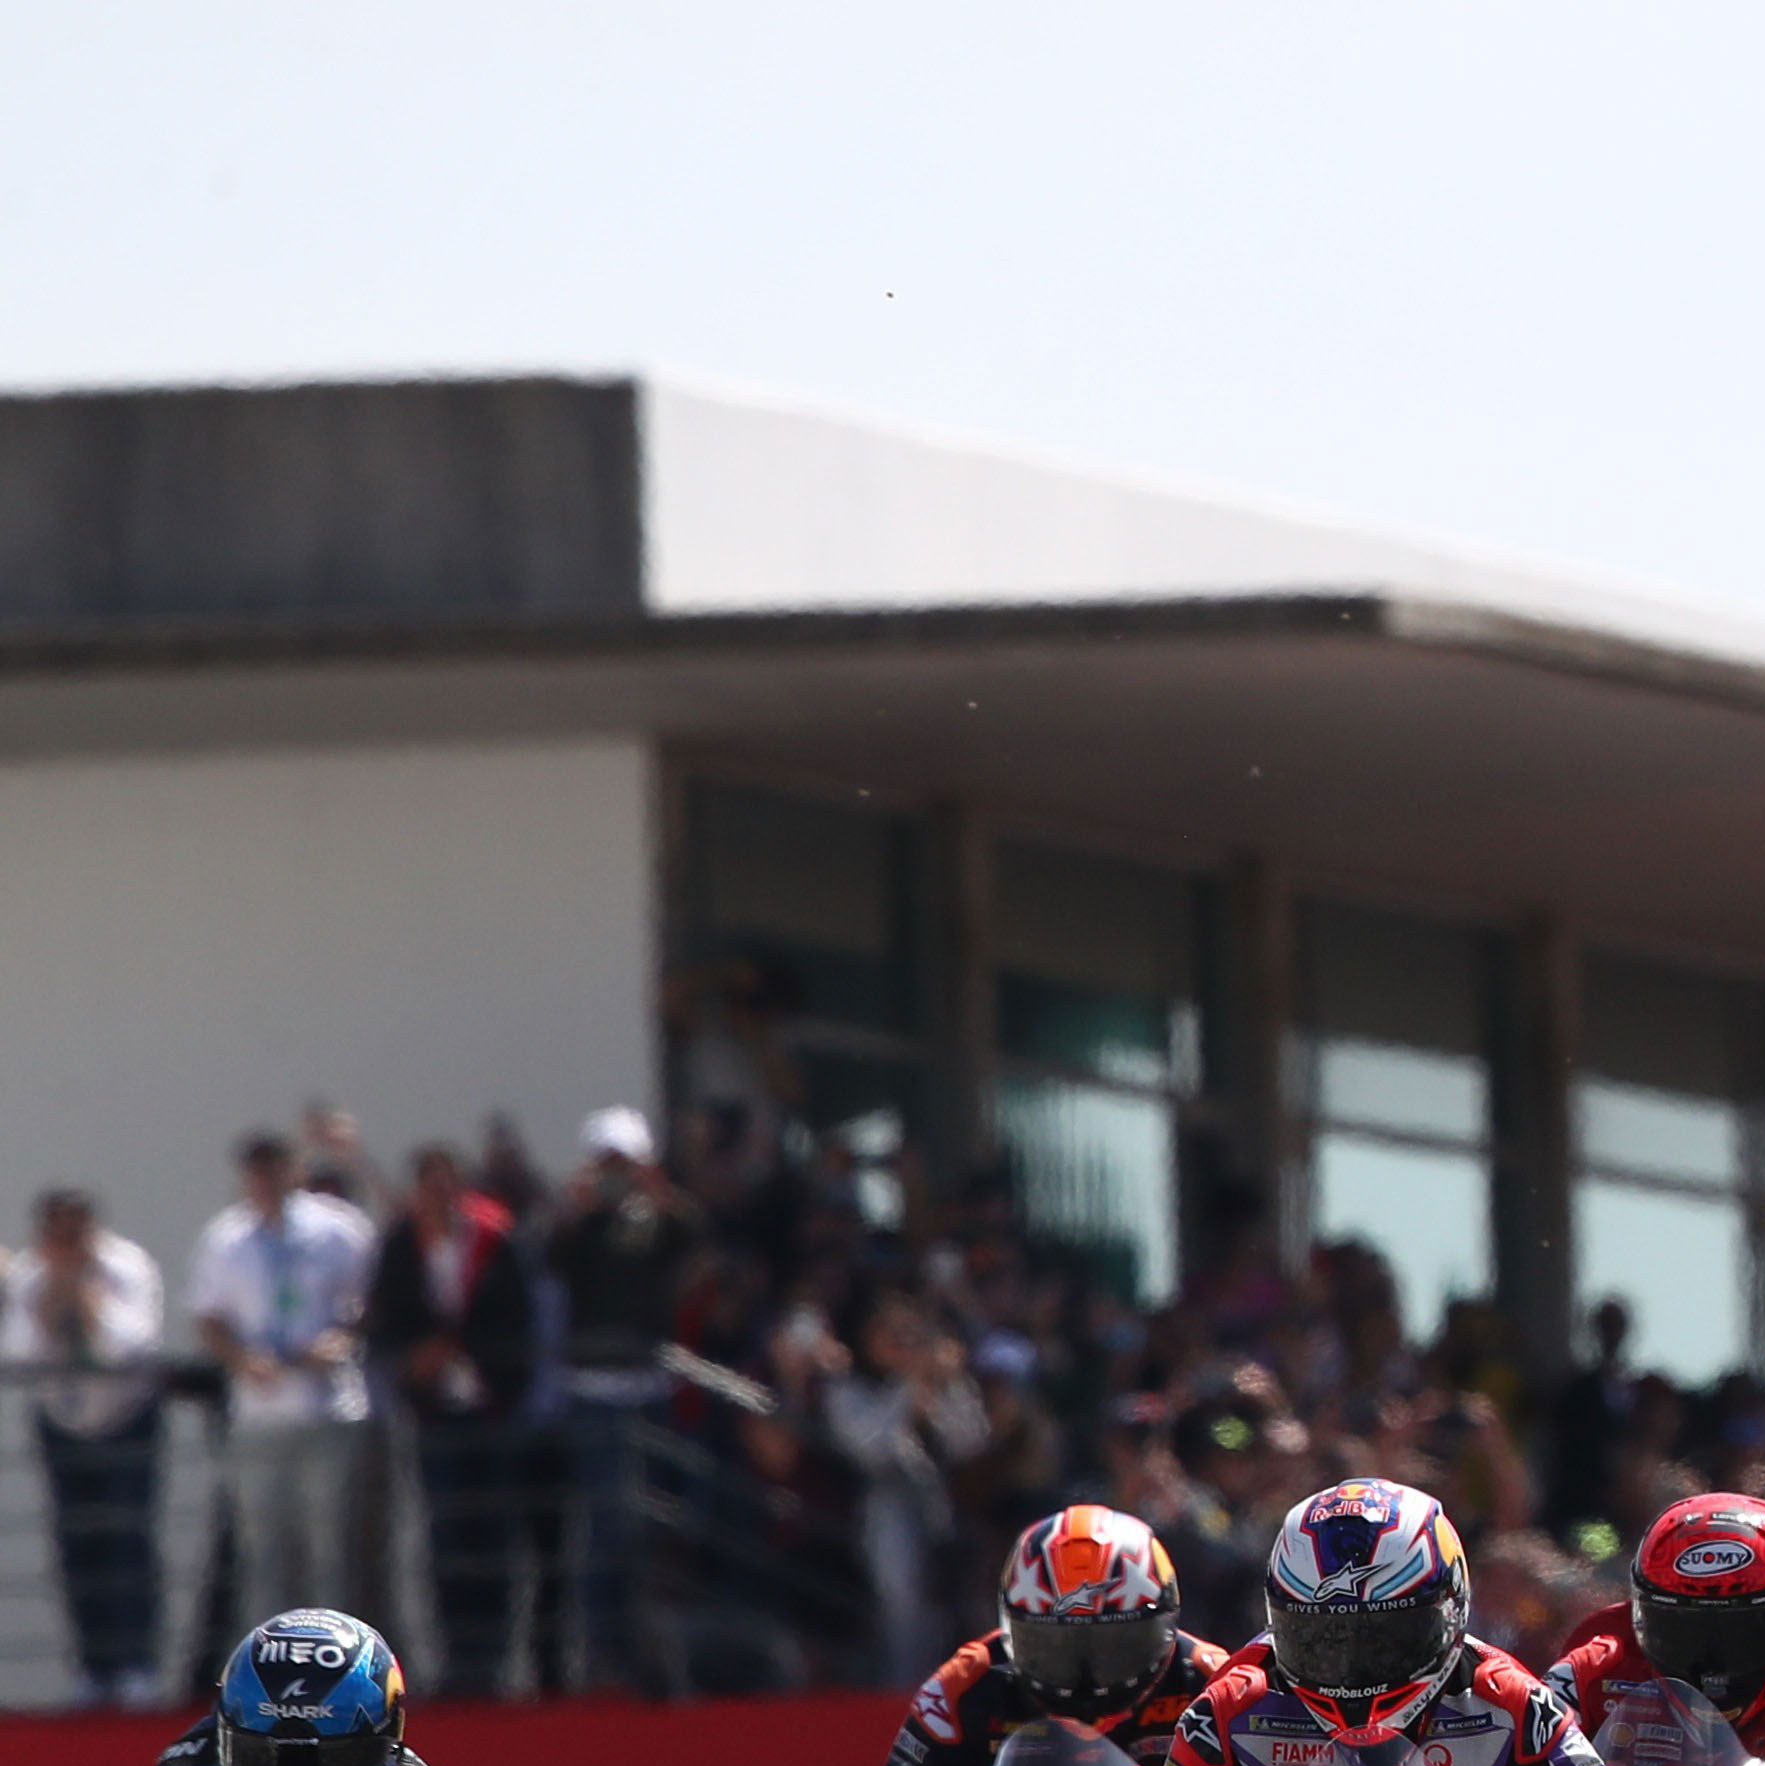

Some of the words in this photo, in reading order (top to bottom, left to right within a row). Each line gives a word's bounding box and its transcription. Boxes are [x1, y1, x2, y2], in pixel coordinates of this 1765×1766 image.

[1310, 1502, 1346, 1524] Red
[1347, 1501, 1390, 1524] Bl
[1680, 1551, 1747, 1567] SUOMY
[1286, 1602, 1321, 1615] GIVES
[1328, 1603, 1359, 1615] YOU
[1366, 1597, 1417, 1613] WINGS
[258, 1640, 346, 1669] MEO
[1318, 1683, 1388, 1698] MOTOBLOUZ
[257, 1700, 335, 1721] SHARK
[1271, 1741, 1335, 1764] FIAMM
